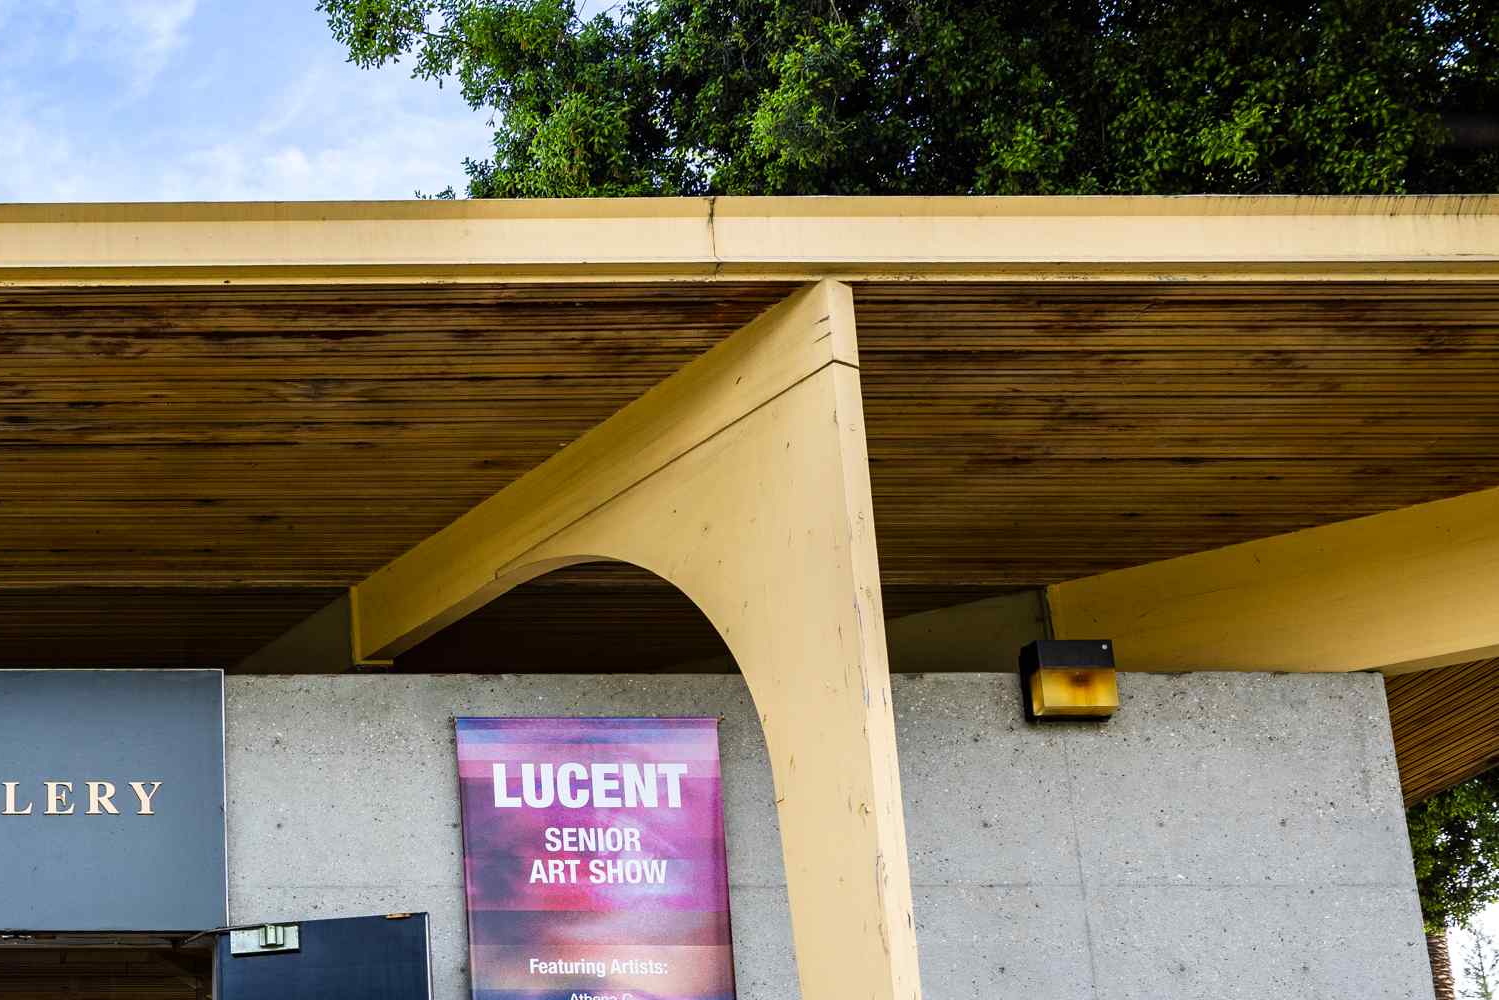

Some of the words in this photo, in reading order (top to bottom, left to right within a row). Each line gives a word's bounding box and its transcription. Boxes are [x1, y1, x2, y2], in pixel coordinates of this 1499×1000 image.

[493, 763, 687, 808] LUCENT
[545, 827, 641, 852] SENIOR
[530, 859, 580, 884] ART
[589, 859, 667, 884] SHOW
[529, 959, 606, 977] Featuring
[610, 959, 668, 975] Artists:
